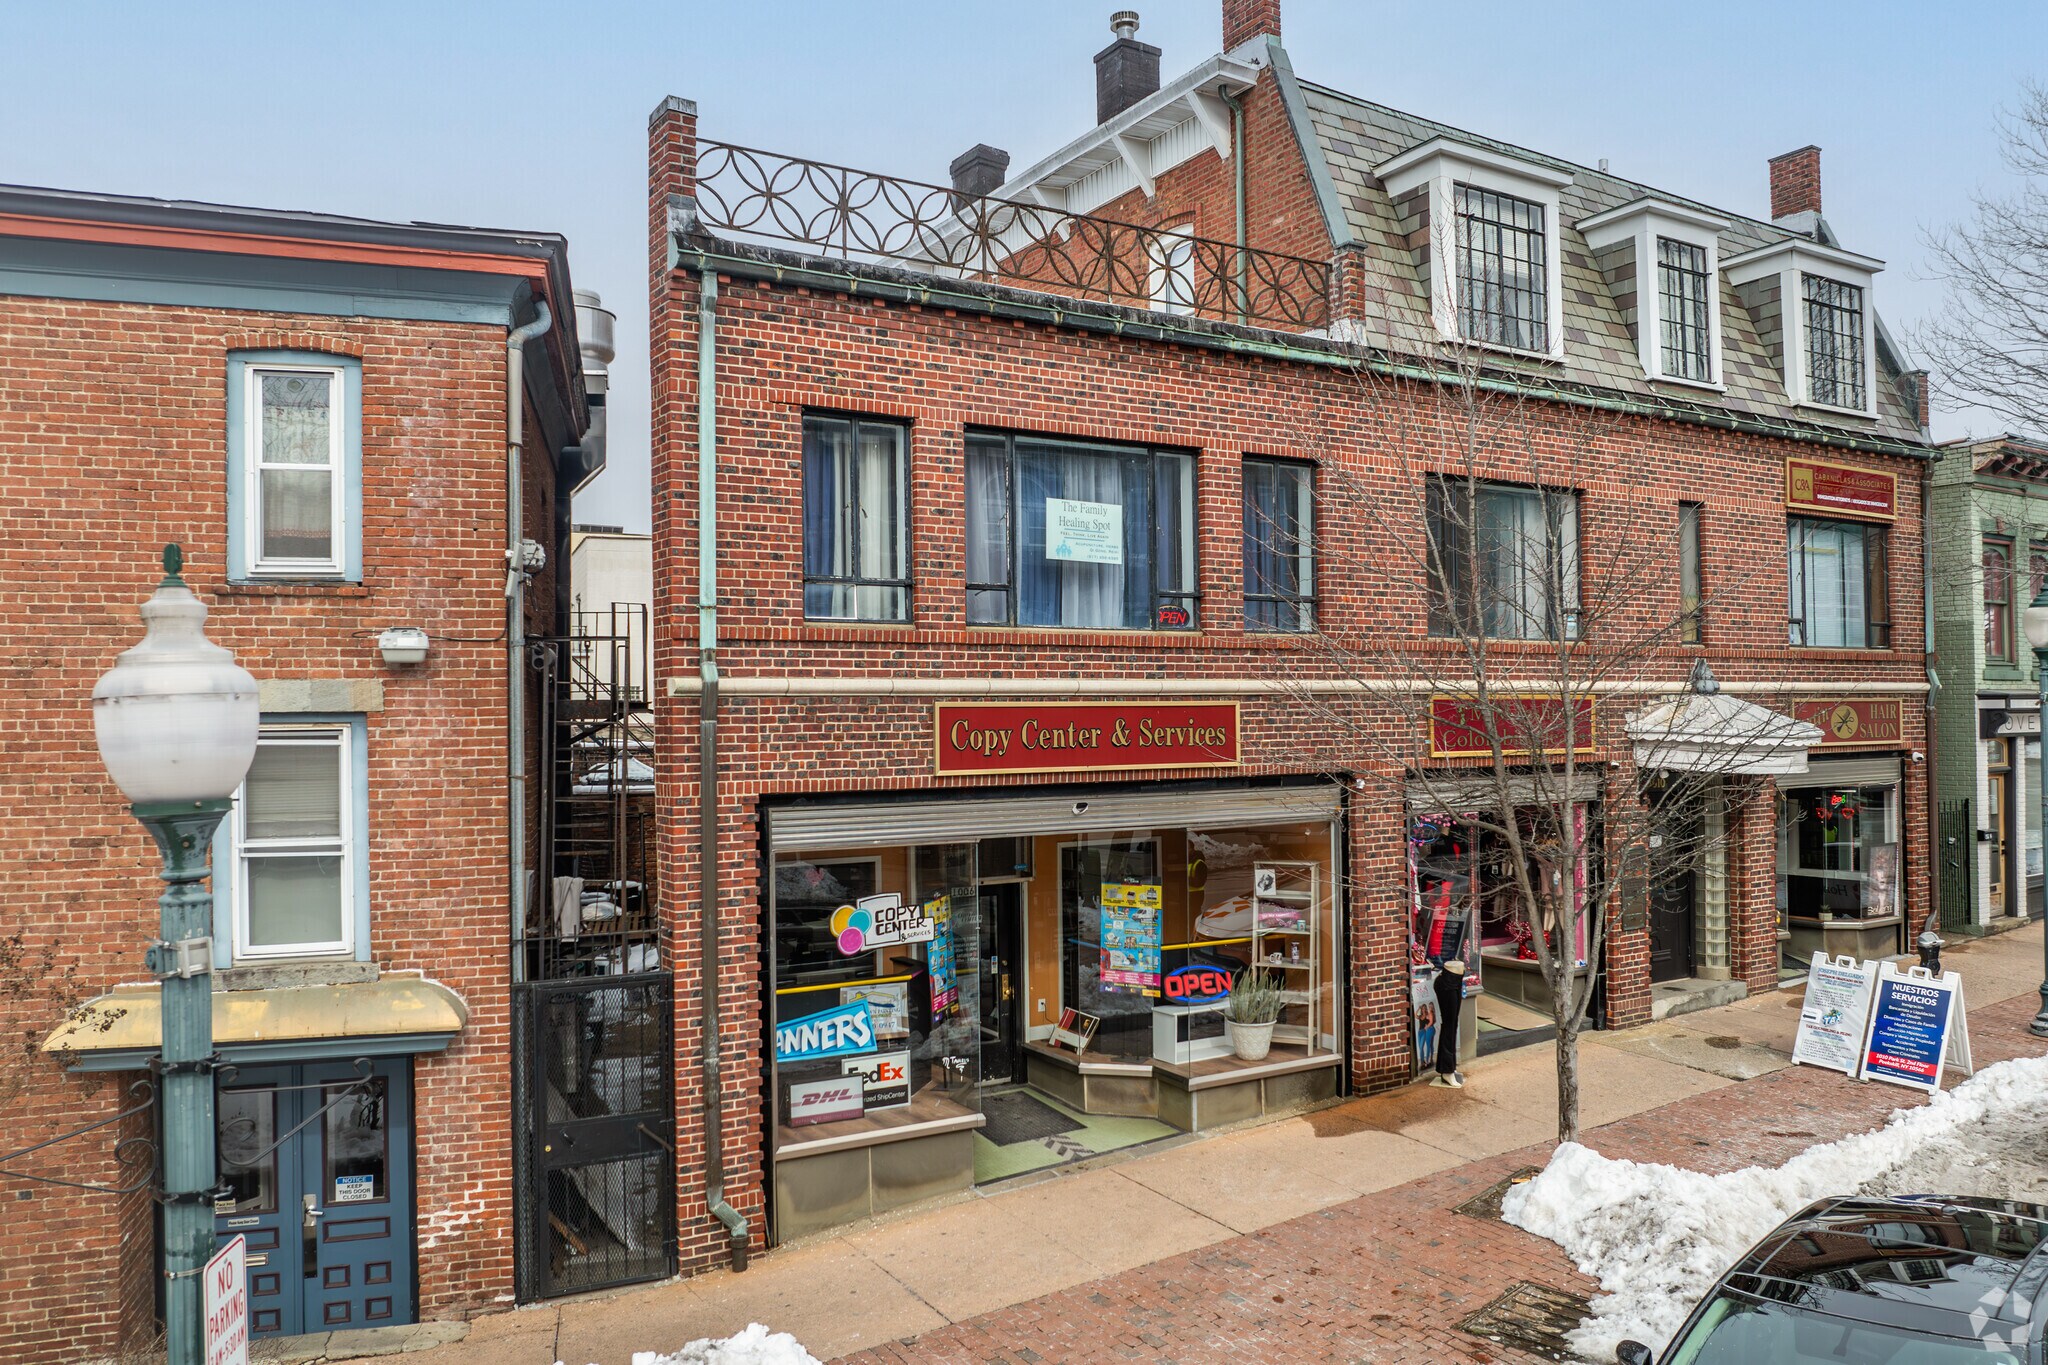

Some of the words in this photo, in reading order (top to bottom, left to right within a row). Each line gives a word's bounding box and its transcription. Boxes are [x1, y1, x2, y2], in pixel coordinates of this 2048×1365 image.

[1794, 478, 1810, 491] C&A
[1061, 501, 1077, 512] The
[1080, 503, 1107, 516] Family
[1058, 516, 1090, 529] Healing
[1092, 519, 1110, 531] Spot
[1870, 704, 1896, 719] HAIR
[951, 719, 1012, 756] Copy
[1020, 719, 1101, 749] Center
[1111, 718, 1131, 747] &
[1139, 717, 1226, 746] Services
[1860, 723, 1897, 738] SALON
[875, 906, 917, 923] COPY
[876, 918, 927, 936] CENTER
[901, 932, 907, 942] &
[907, 930, 931, 938] SERVICES
[1817, 967, 1837, 975] JOSEPH
[1838, 971, 1864, 980] DELGADO
[1165, 971, 1232, 997] OPEN
[1892, 983, 1939, 997] NUESTROS
[1891, 991, 1937, 1006] SERVICIOS
[801, 1088, 853, 1106] DHL
[877, 1091, 906, 1101] ShipCenter
[218, 1261, 233, 1298] NO
[210, 1288, 243, 1345] PARKING
